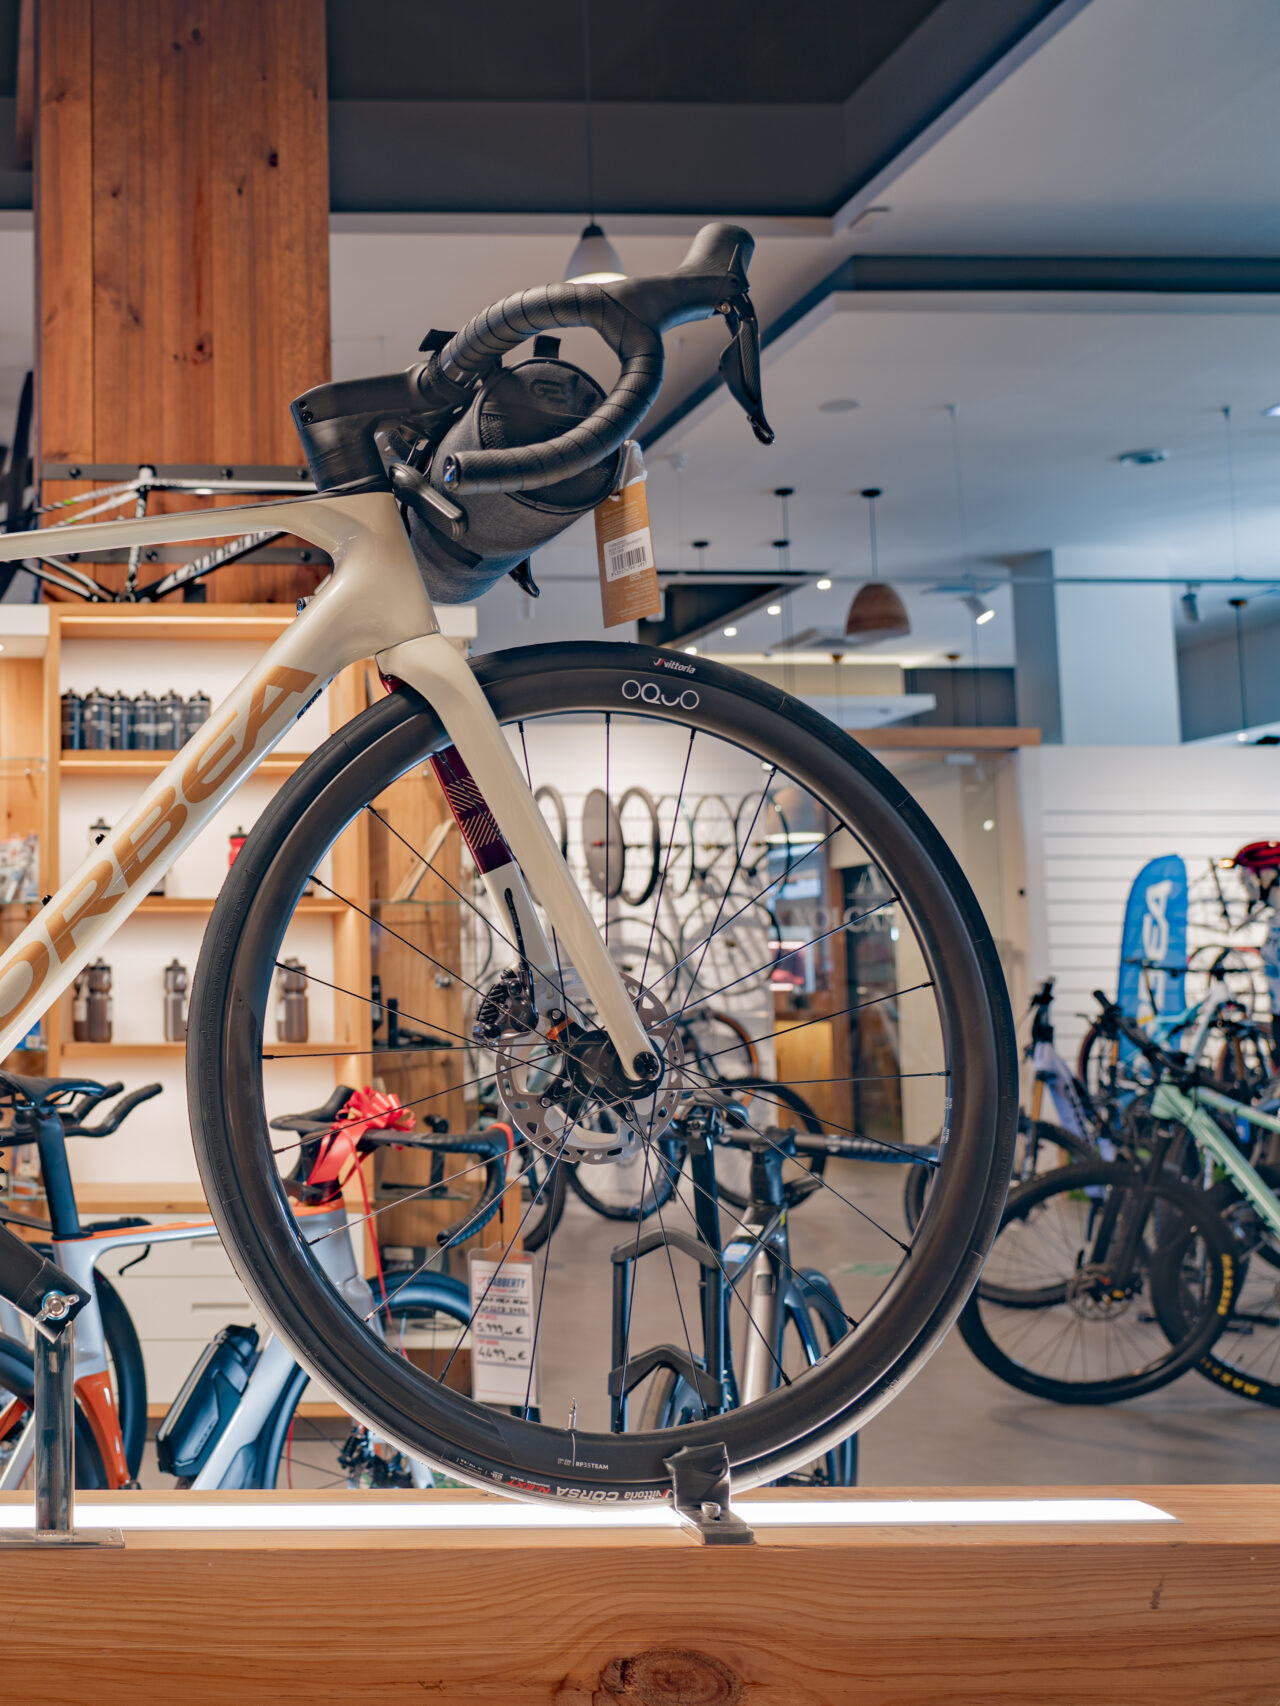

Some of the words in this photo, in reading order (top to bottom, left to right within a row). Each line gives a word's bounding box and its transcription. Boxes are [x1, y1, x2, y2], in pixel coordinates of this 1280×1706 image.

[663, 660, 697, 674] vittoria
[621, 679, 700, 710] OQUO
[556, 1486, 620, 1501] CORSA
[624, 1490, 663, 1501] vittoria
